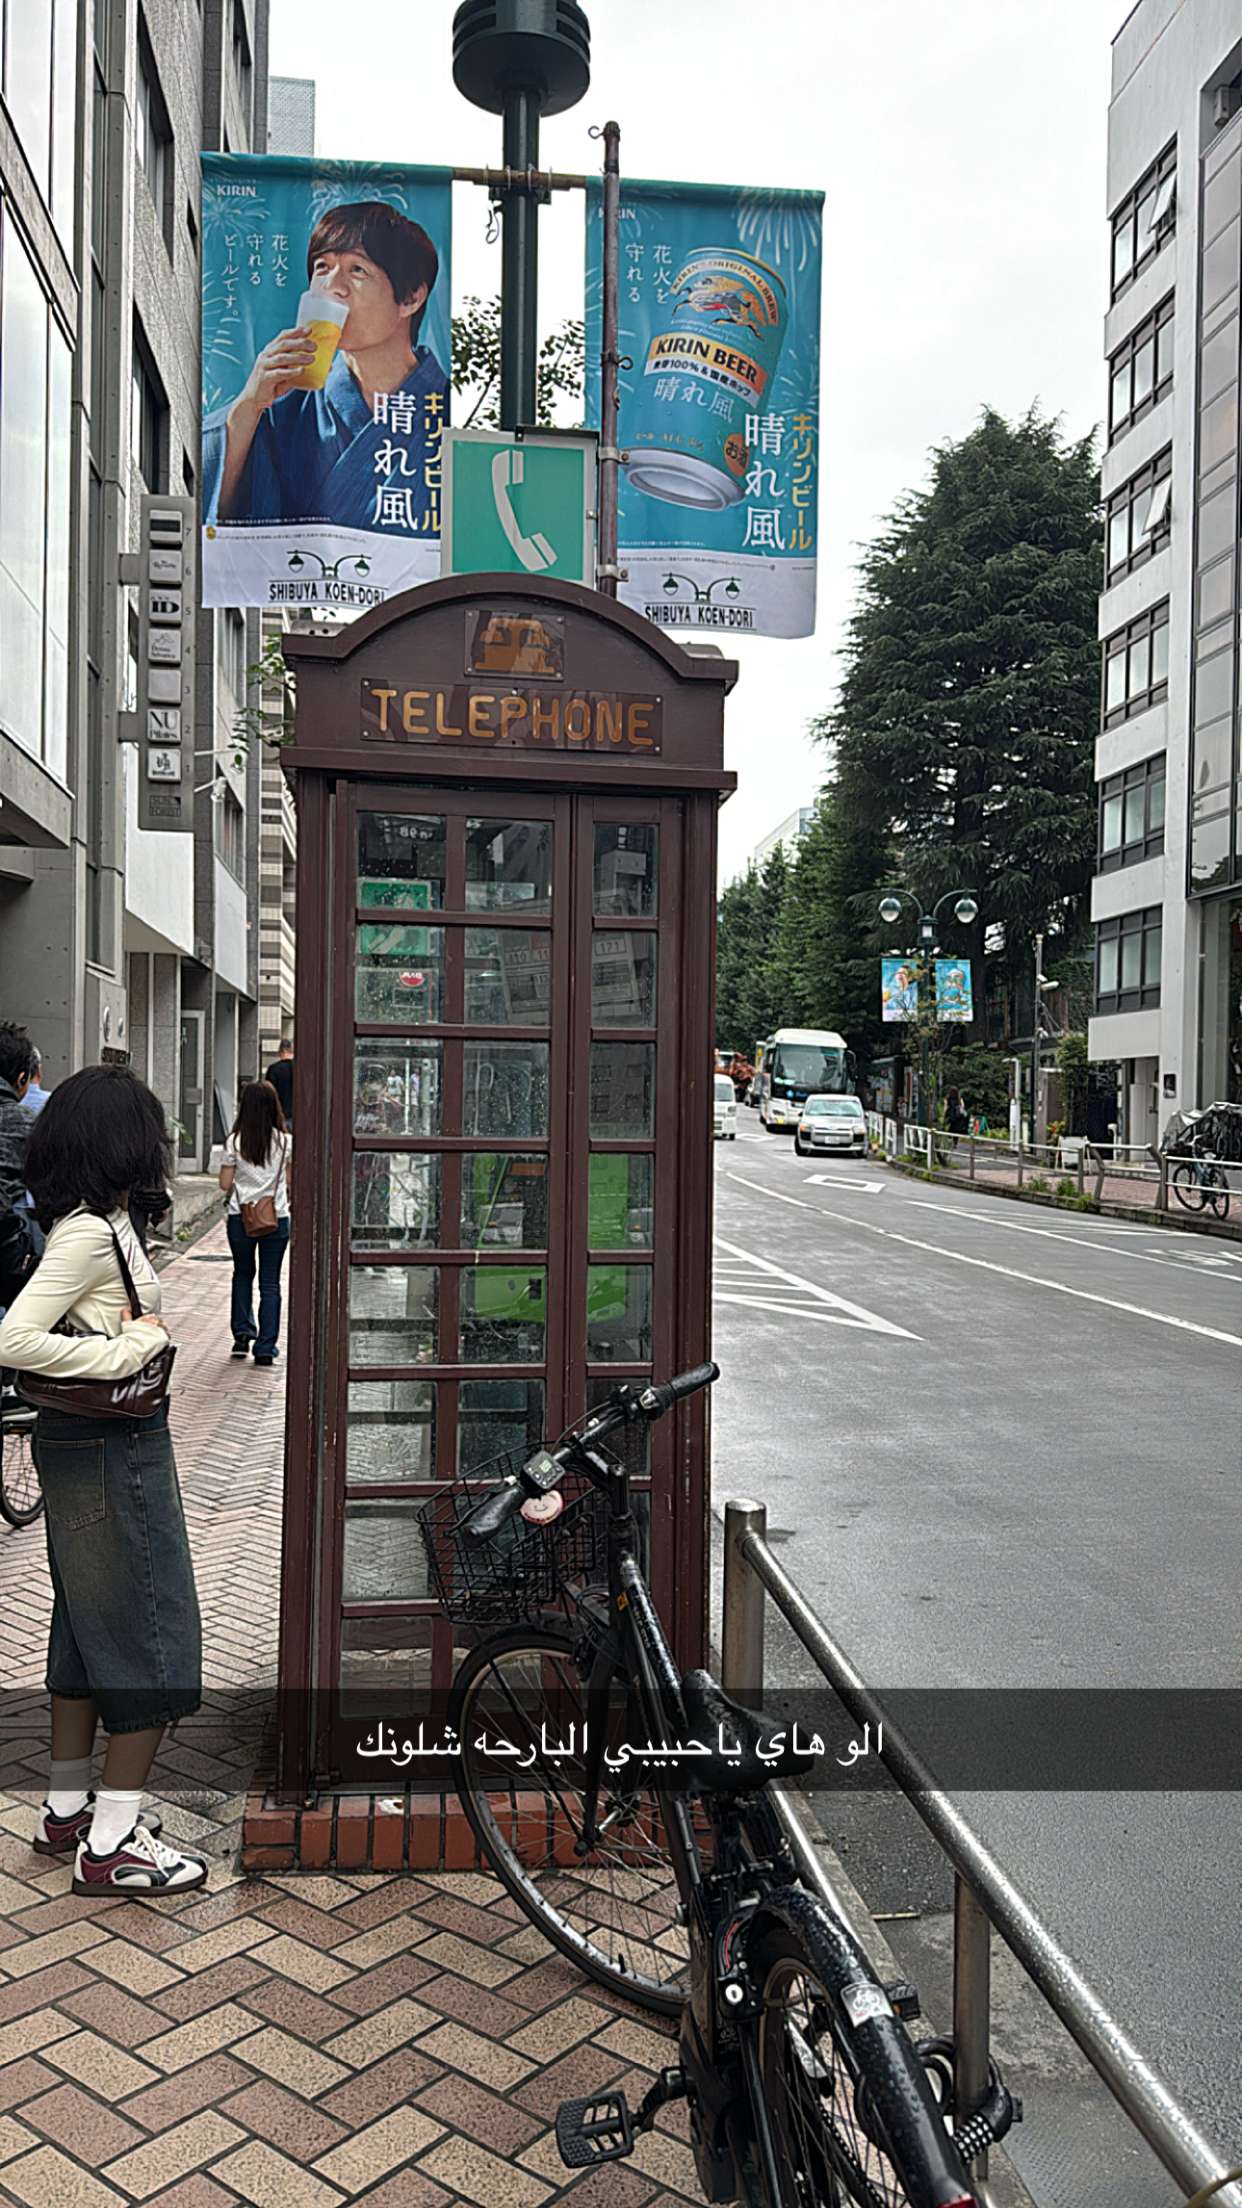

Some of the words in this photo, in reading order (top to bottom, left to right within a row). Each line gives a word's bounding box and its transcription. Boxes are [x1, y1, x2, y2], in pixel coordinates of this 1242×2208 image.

[216, 184, 258, 198] KIRIN
[245, 233, 264, 286] 守れる
[271, 234, 290, 288] 花火を
[623, 241, 645, 303] 守れる
[652, 243, 673, 305] 花火を
[655, 335, 710, 359] KIRIN
[714, 347, 758, 384] BEER
[653, 376, 735, 423] 晴れ風
[371, 391, 419, 531] 晴れ風
[742, 413, 786, 551] 晴れ風
[788, 414, 813, 550] キリンビール
[269, 583, 318, 601] SHIBUYA
[324, 583, 386, 606] KOEN-DORI
[645, 606, 692, 624] SHIBUYA
[698, 607, 753, 627] KOEN-DORI
[370, 688, 655, 746] TELEPHONE
